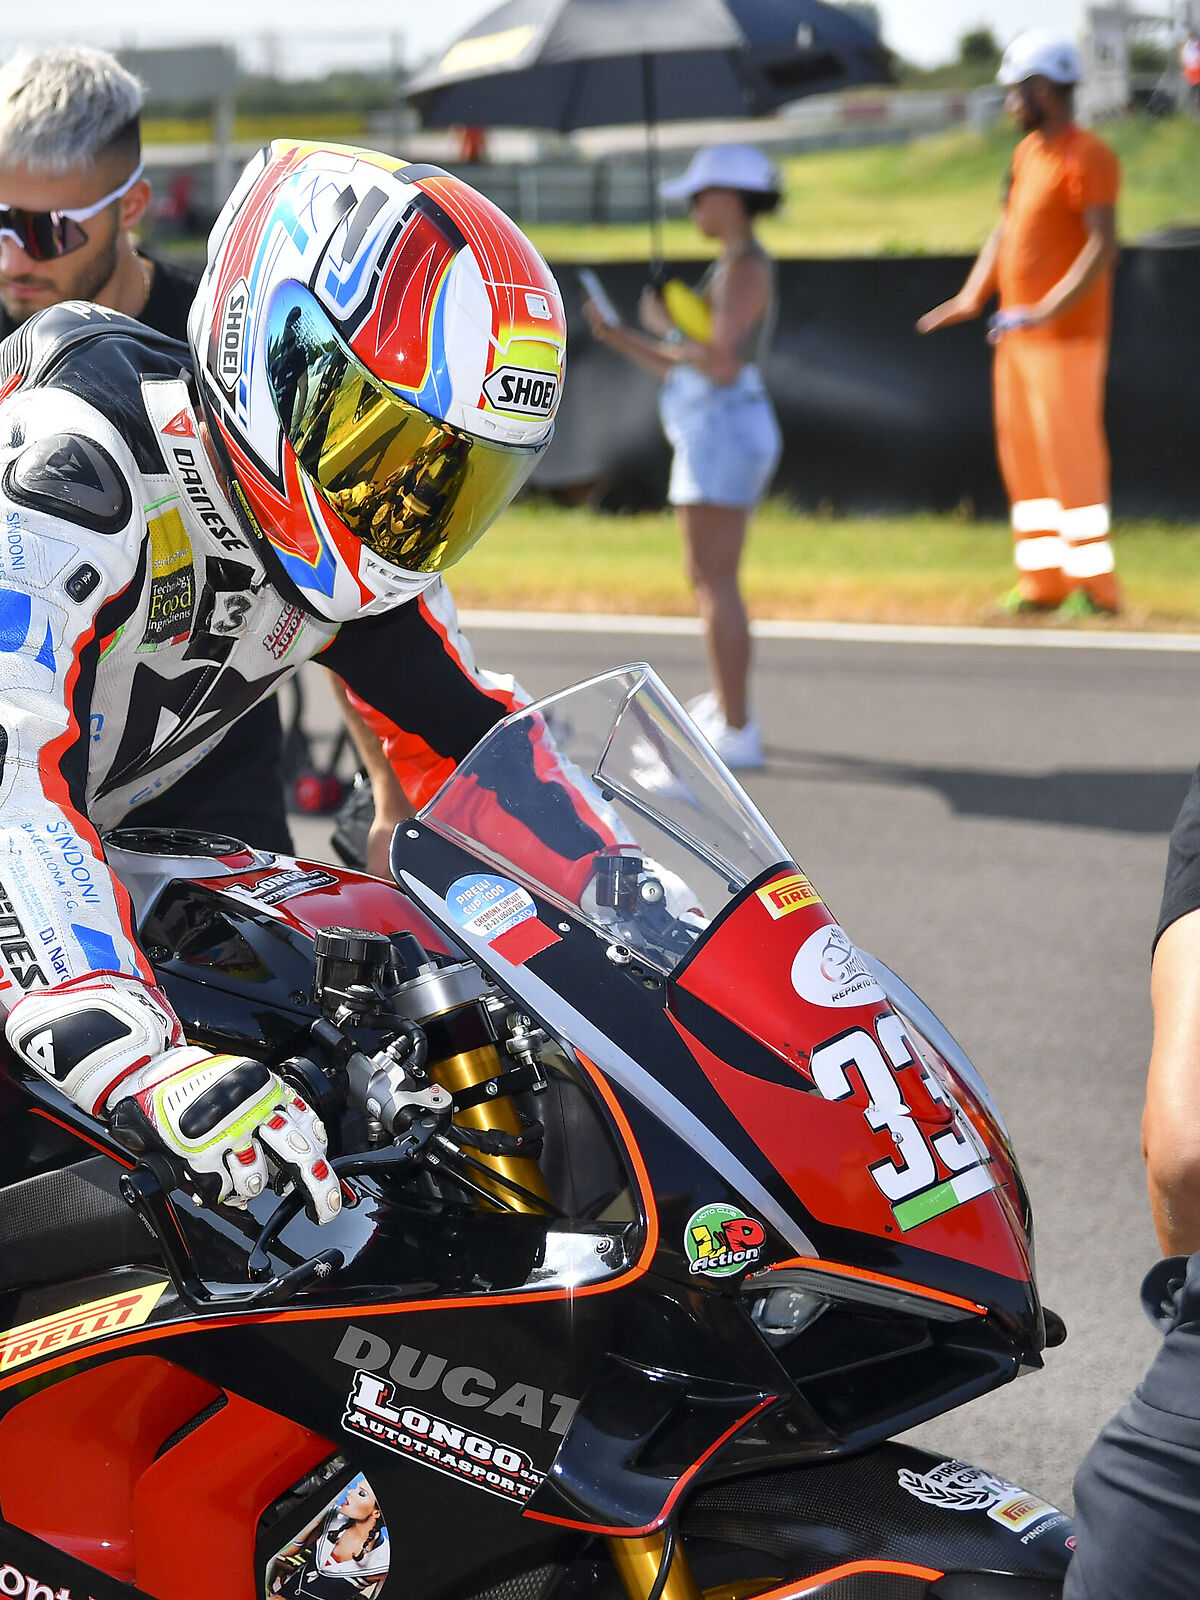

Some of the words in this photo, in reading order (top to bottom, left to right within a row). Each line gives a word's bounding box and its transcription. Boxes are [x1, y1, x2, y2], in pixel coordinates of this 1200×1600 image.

[222, 294, 246, 375] SHOEI
[498, 375, 556, 408] SHOEI
[173, 448, 249, 551] DAINESE
[150, 583, 192, 619] Food
[263, 603, 296, 650] LONG
[272, 609, 307, 659] AUTOT
[20, 822, 66, 887] BARCELLONA
[46, 821, 101, 905] SINDONI
[455, 878, 492, 905] PIRELLI
[462, 898, 482, 916] CUP
[481, 884, 506, 903] 1000
[768, 880, 816, 910] PIREL
[473, 905, 502, 927] CREMONA
[500, 892, 522, 911] CIRCUIT
[497, 906, 516, 923] LUGLIO
[39, 926, 57, 946] Di
[831, 979, 870, 1002] REPARTO
[810, 1011, 995, 1202] 33
[696, 1208, 715, 1223] MOTO
[692, 1248, 759, 1271] Action
[333, 1325, 580, 1436] DUCAT
[352, 1374, 523, 1474] LONGO
[929, 1457, 974, 1483] PIREL
